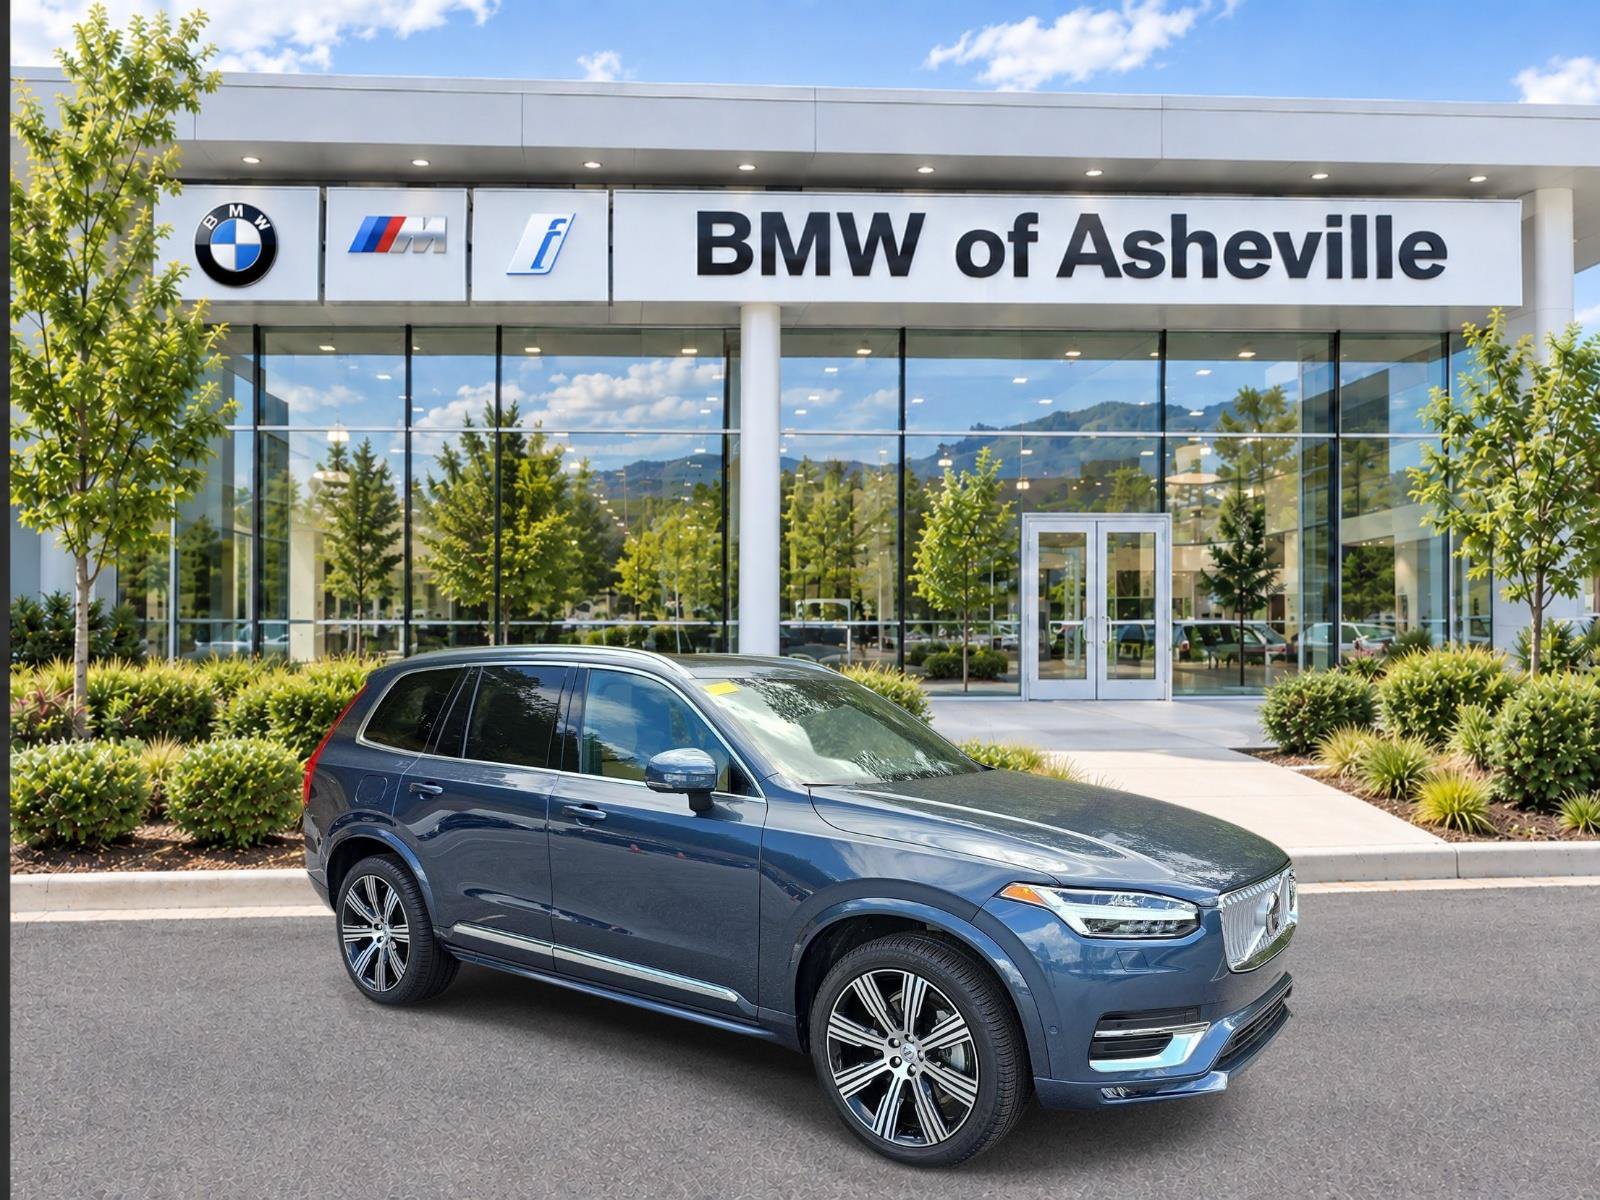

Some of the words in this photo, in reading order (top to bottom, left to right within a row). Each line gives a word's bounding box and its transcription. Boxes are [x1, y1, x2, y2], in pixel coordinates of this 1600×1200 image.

[202, 204, 271, 231] BMW
[696, 210, 926, 277] BMW
[955, 212, 1039, 279] of
[1056, 213, 1449, 280] Asheville
